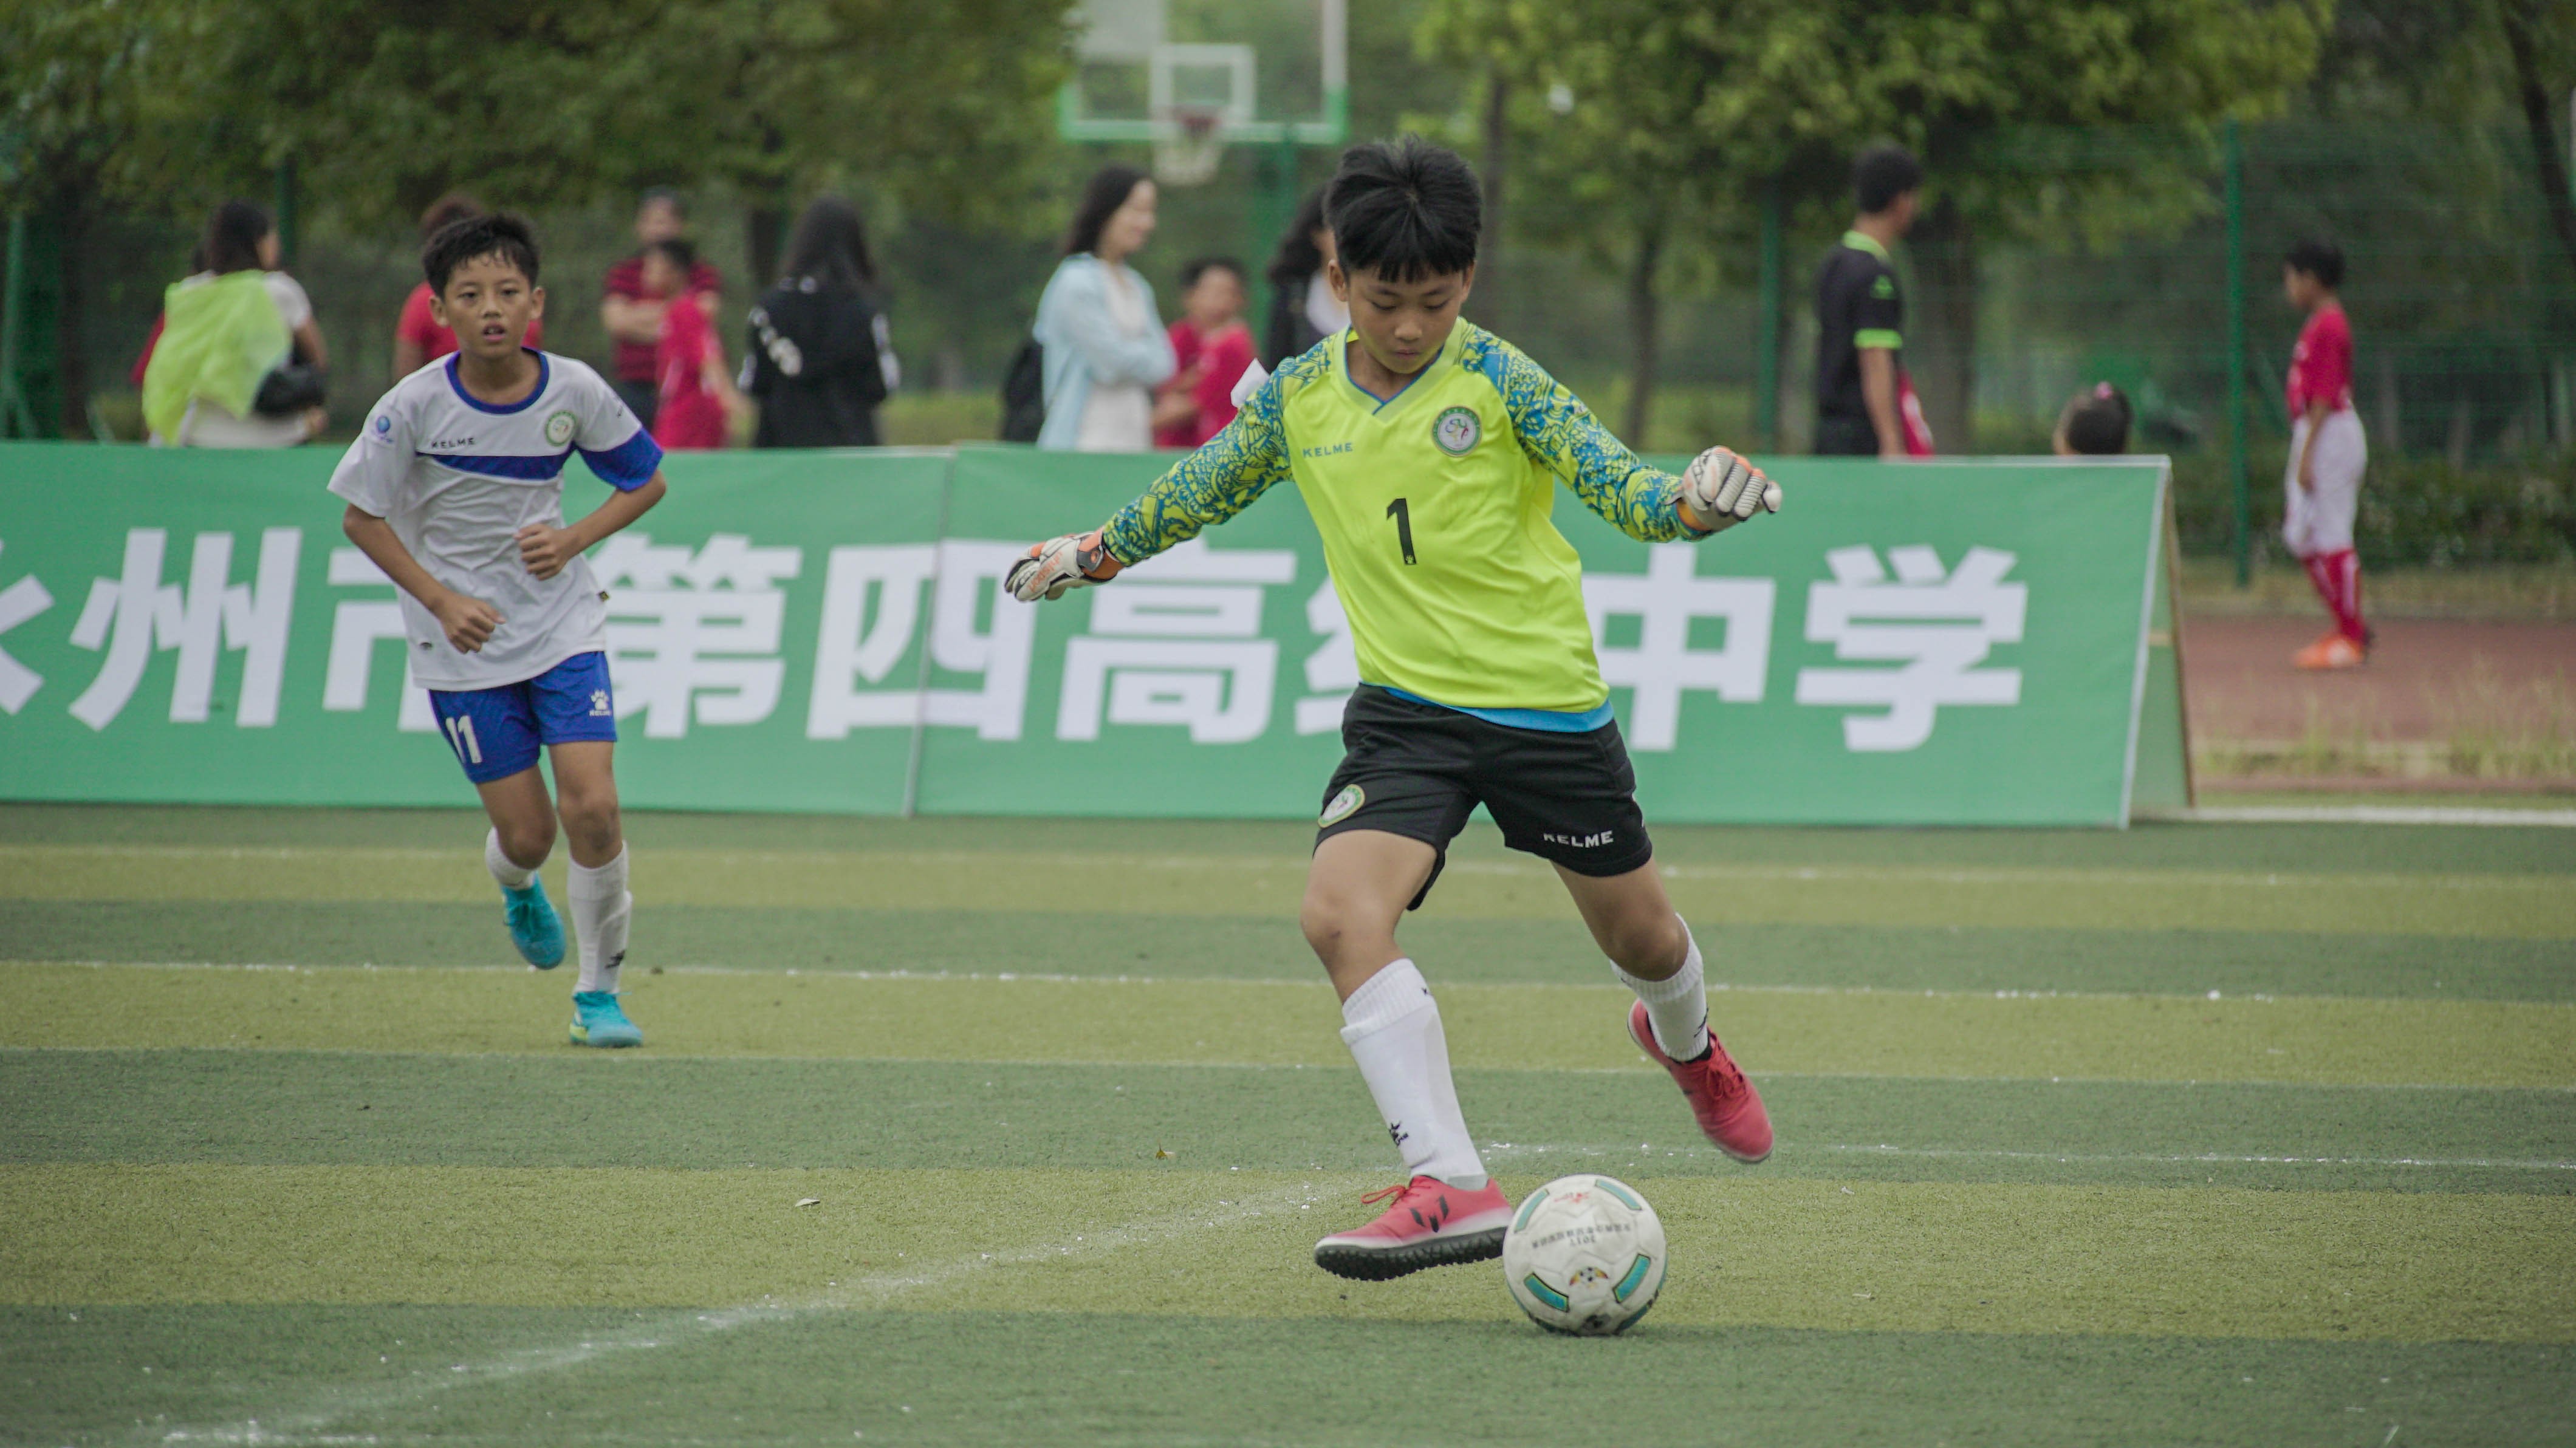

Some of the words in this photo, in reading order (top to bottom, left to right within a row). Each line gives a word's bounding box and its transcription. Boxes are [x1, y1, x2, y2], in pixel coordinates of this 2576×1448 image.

[431, 437, 475, 449] KELME
[1303, 442, 1353, 458] KELME
[1386, 497, 1417, 565] 1
[445, 715, 482, 764] 11
[1543, 830, 1614, 849] KELME
